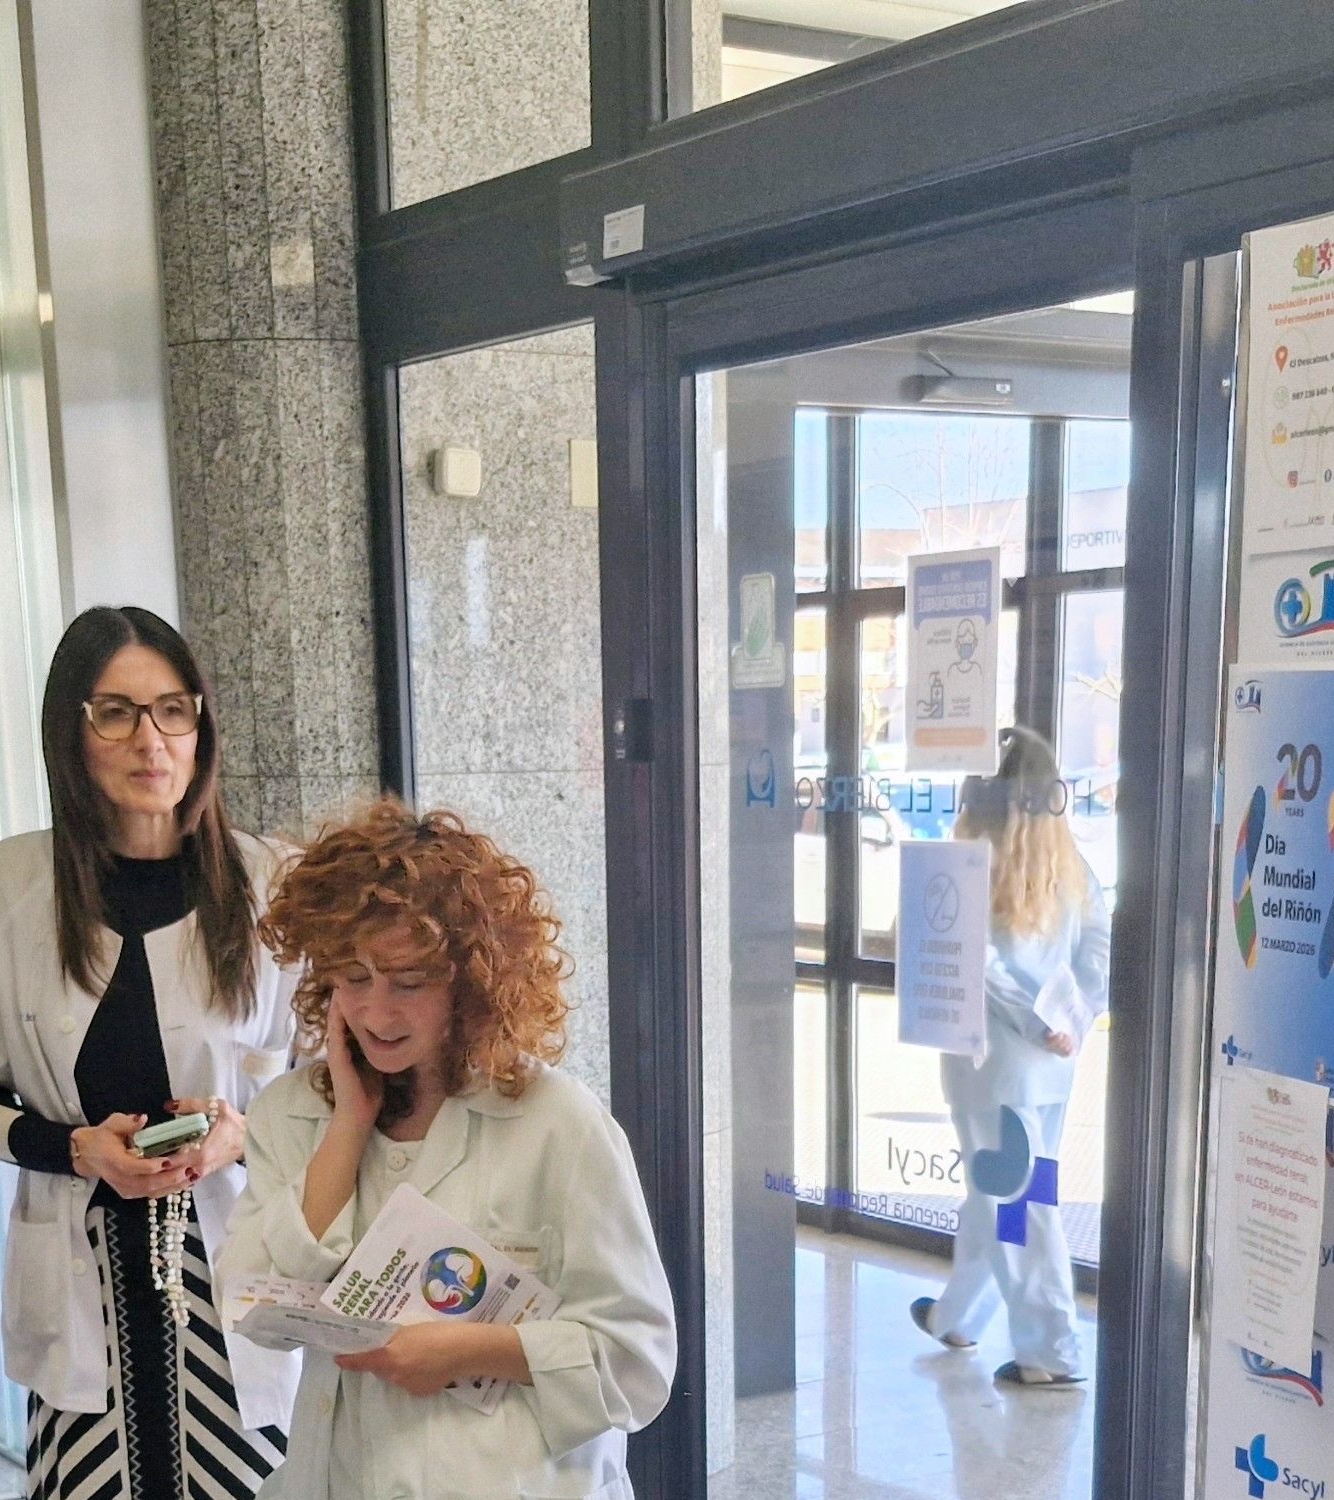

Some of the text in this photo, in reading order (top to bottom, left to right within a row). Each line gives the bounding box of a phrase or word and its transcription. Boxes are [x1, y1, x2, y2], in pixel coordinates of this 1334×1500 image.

[1275, 743, 1323, 802] 20
[1266, 834, 1286, 855] Día
[1264, 866, 1315, 891] Mundial
[1262, 898, 1321, 924] del Riñón
[375, 1248, 407, 1288] TODOS
[332, 1270, 362, 1308] SALUD
[342, 1278, 373, 1316] RENAL
